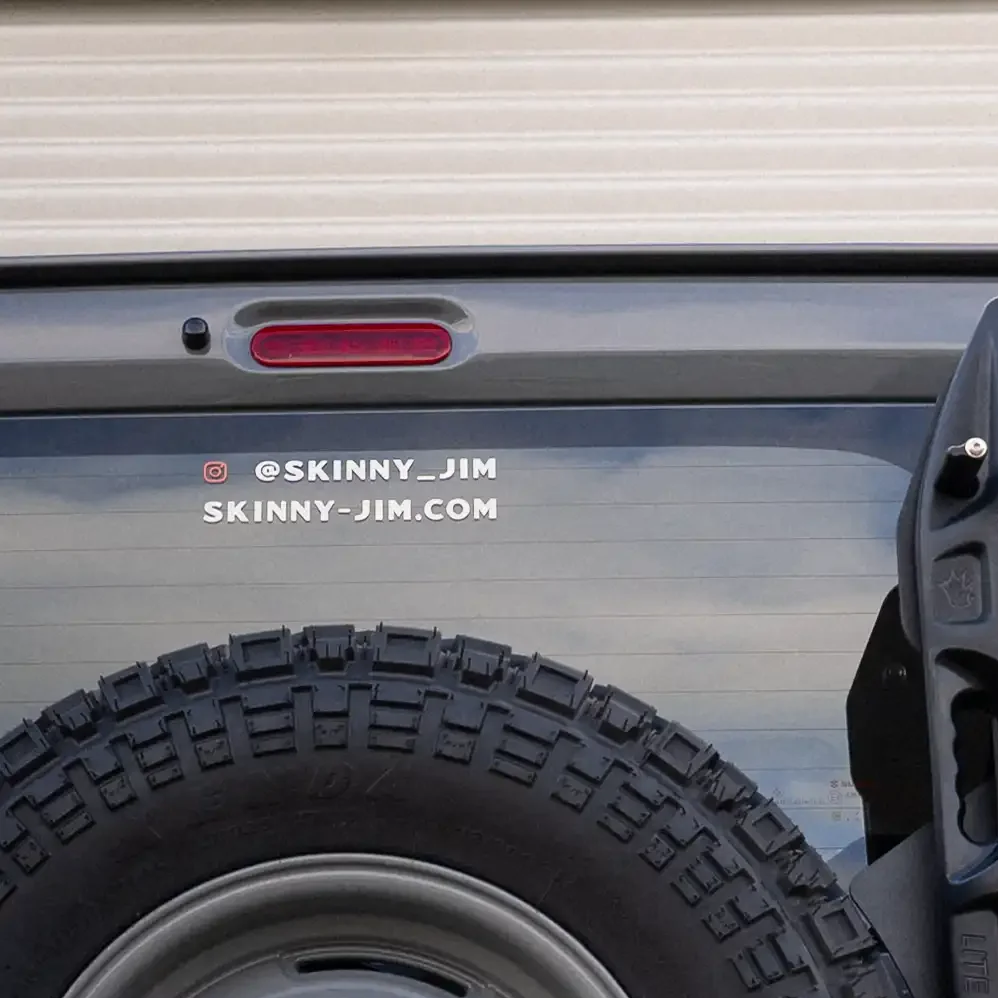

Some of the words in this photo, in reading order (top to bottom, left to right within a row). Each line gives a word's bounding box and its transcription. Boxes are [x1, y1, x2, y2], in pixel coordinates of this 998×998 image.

[254, 457, 496, 482] @SKINNY_JIM
[203, 497, 498, 524] SKINNY-JIM.COM
[960, 932, 991, 996] LITE
